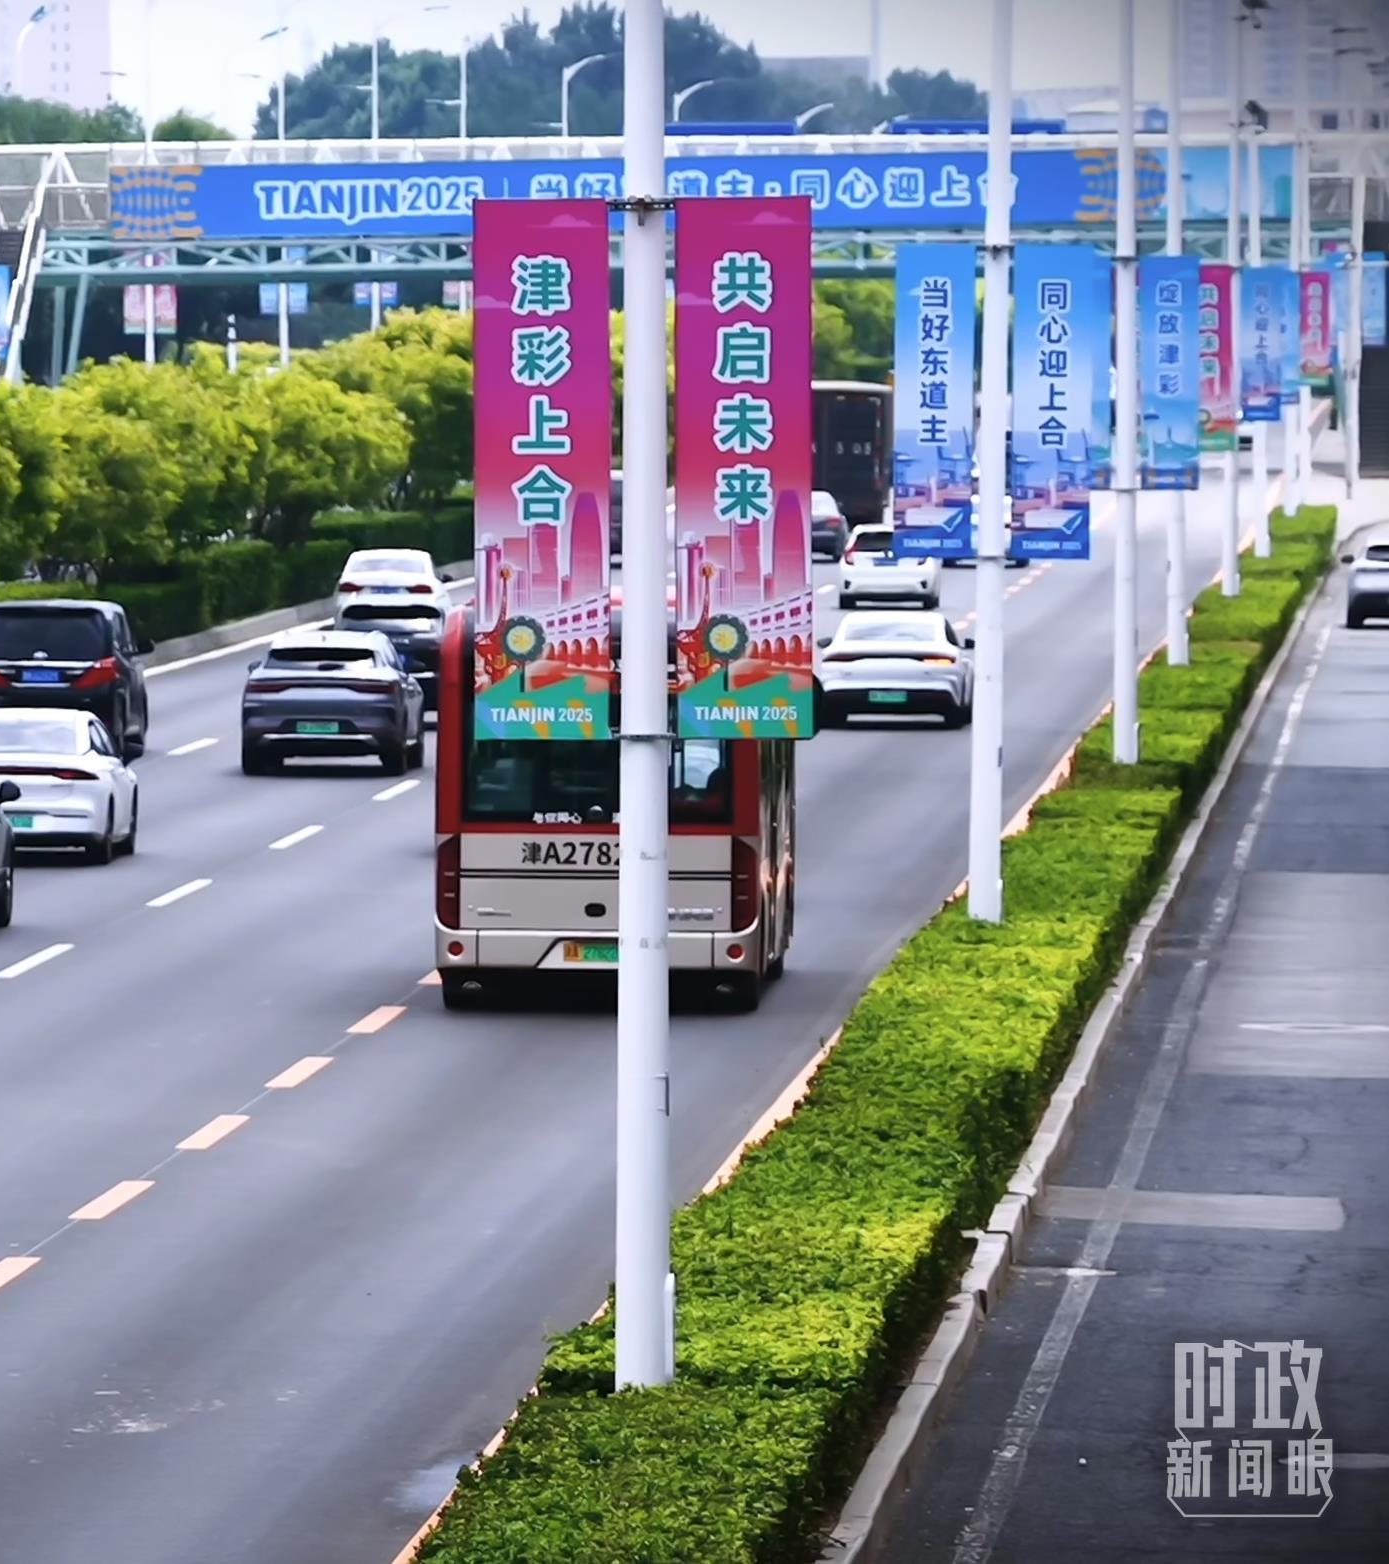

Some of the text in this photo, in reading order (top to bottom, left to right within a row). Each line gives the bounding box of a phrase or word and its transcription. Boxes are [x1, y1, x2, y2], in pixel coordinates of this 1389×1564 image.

[259, 180, 481, 221] TIANJIN 2025
[514, 257, 569, 523] 津彩上合
[714, 254, 770, 521] 共启未来
[918, 278, 951, 445] 当好东道主
[1037, 280, 1070, 447] 同心迎上合
[490, 706, 593, 726] TIANJIN 2025
[694, 705, 798, 724] TIANJIN 2025
